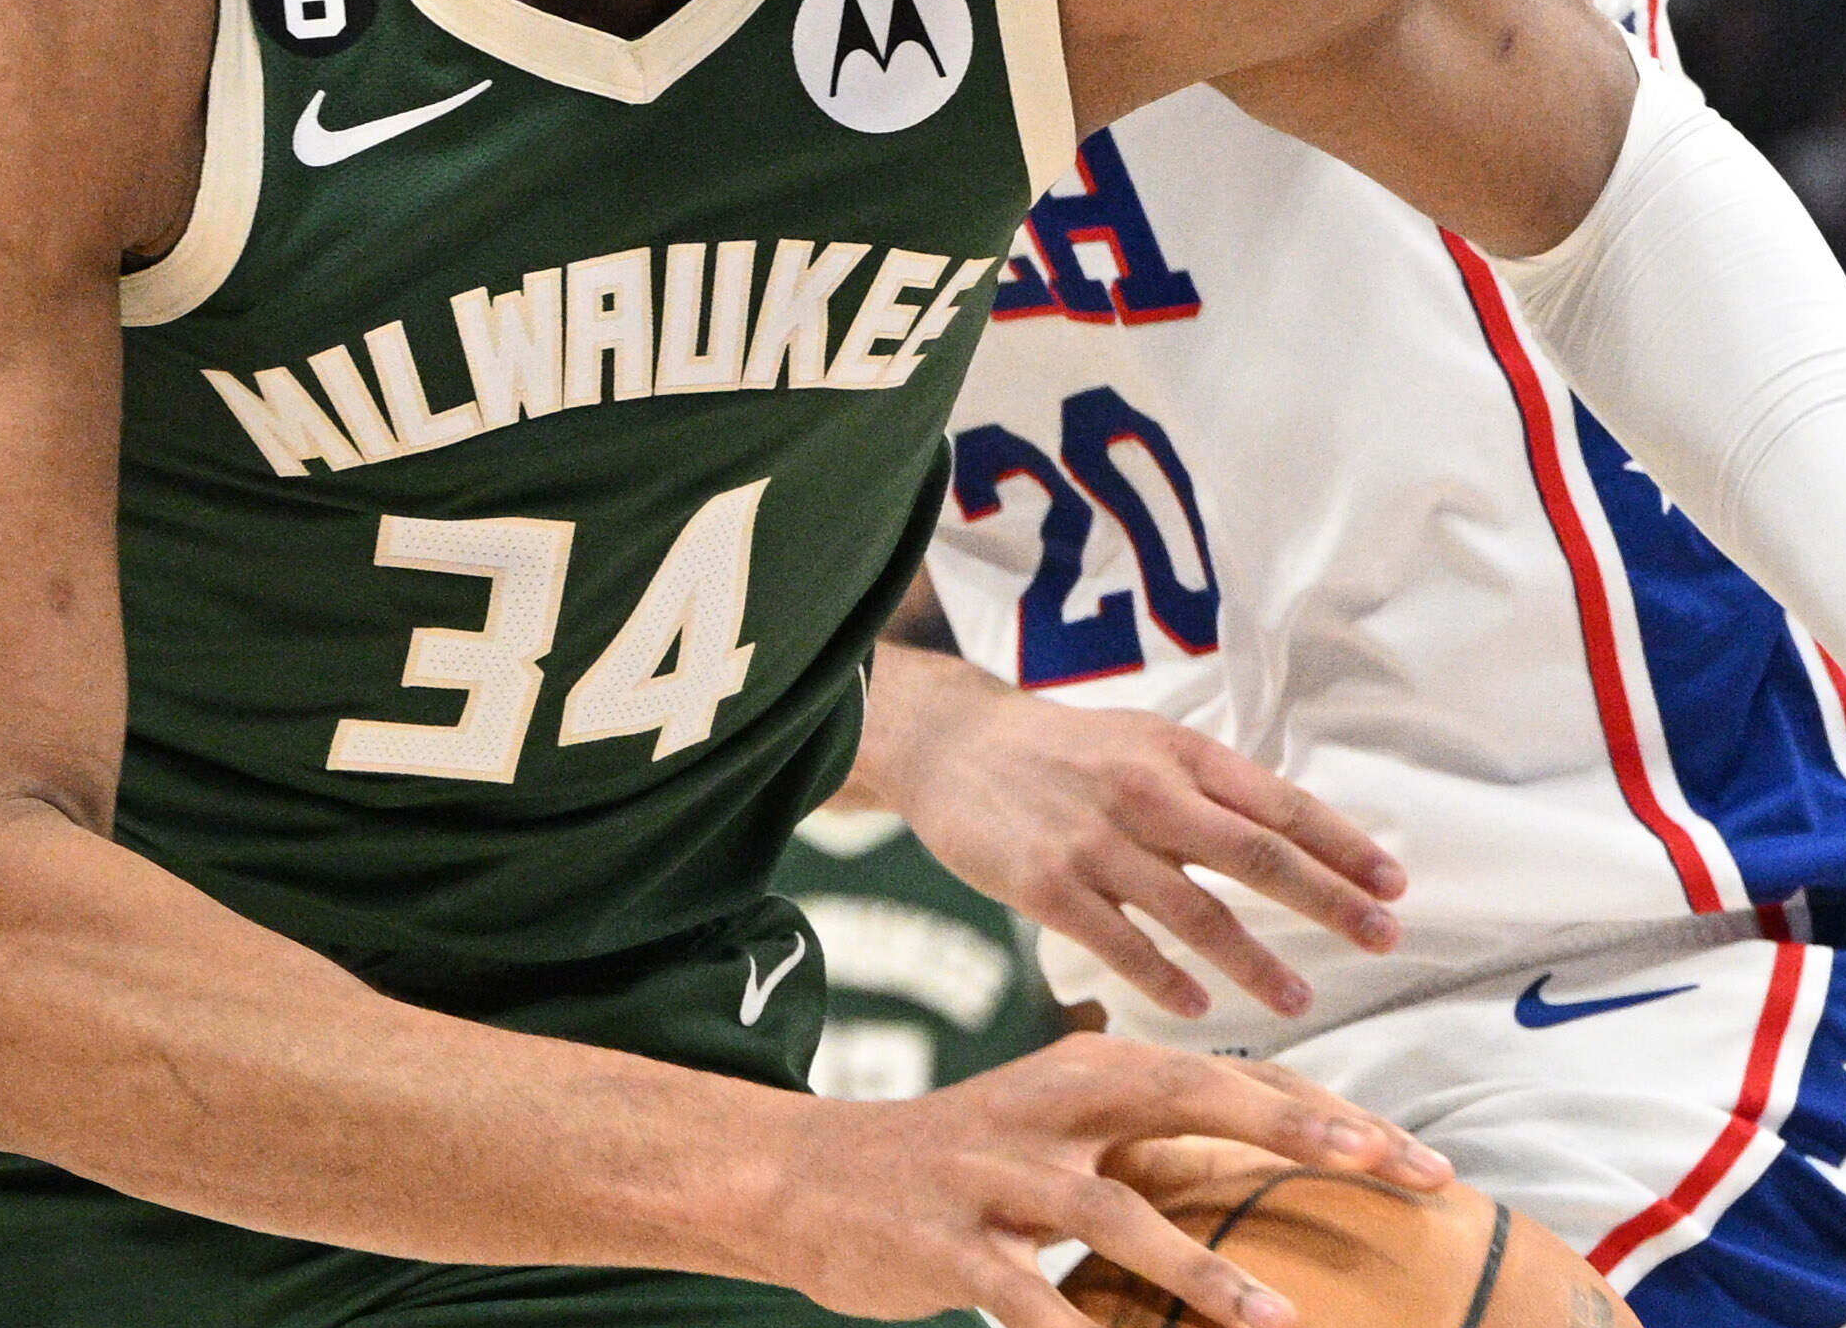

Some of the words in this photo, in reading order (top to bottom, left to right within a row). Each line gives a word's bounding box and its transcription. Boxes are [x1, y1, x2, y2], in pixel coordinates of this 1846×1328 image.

[202, 240, 997, 476] MILWAUKEE
[326, 478, 771, 784] 34
[953, 385, 1221, 689] 20
